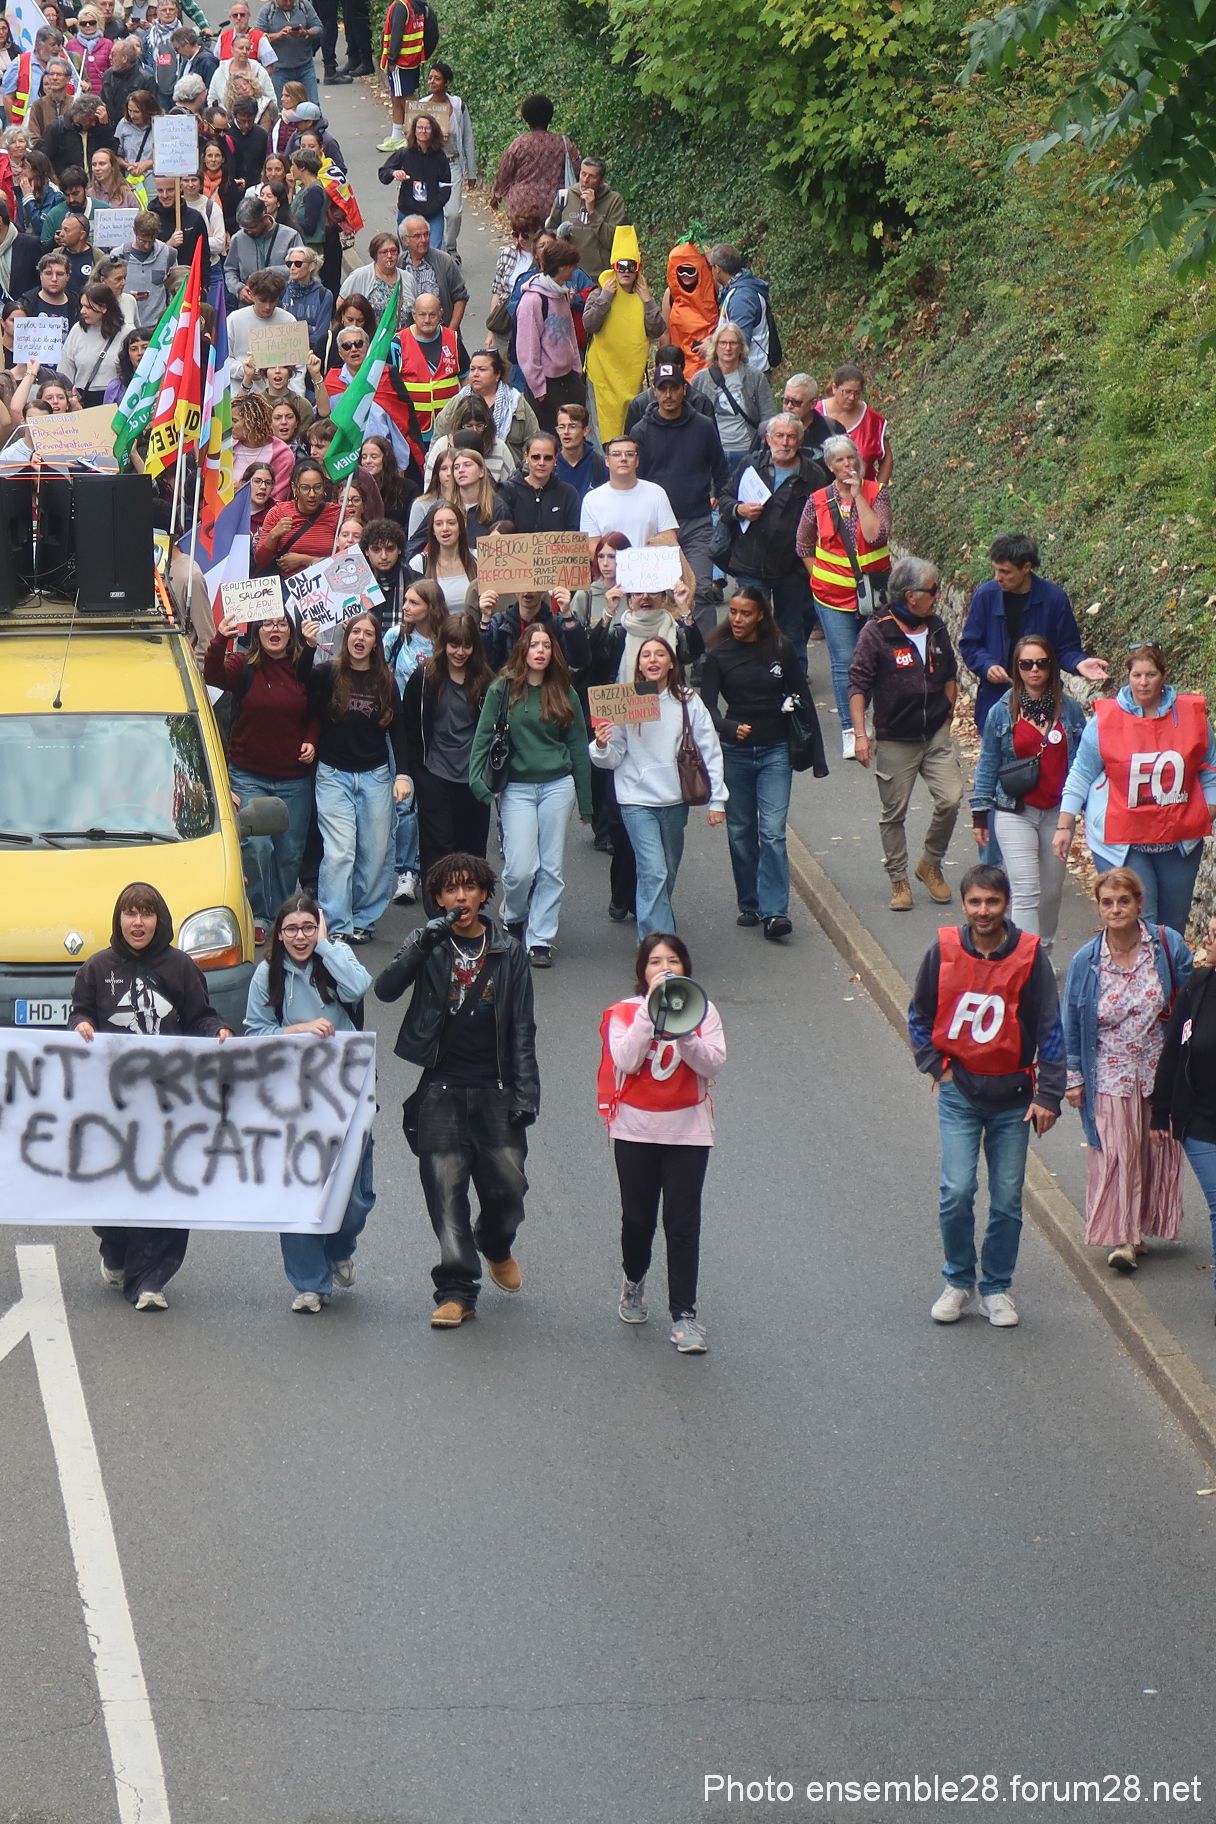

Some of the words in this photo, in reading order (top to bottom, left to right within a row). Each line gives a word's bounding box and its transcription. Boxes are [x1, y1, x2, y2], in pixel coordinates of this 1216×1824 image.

[532, 546, 544, 556] LE
[533, 556, 551, 567] NOUS
[287, 572, 309, 590] ON
[291, 574, 322, 601] VEUT
[533, 575, 557, 587] NOTRE
[238, 587, 275, 602] SALOPE
[299, 590, 323, 611] PAS
[301, 601, 327, 620] FINIR
[895, 652, 914, 666] cgt
[596, 704, 613, 717] PAS
[614, 703, 628, 715] LES
[1127, 749, 1185, 809] FO
[947, 991, 1006, 1044] FO
